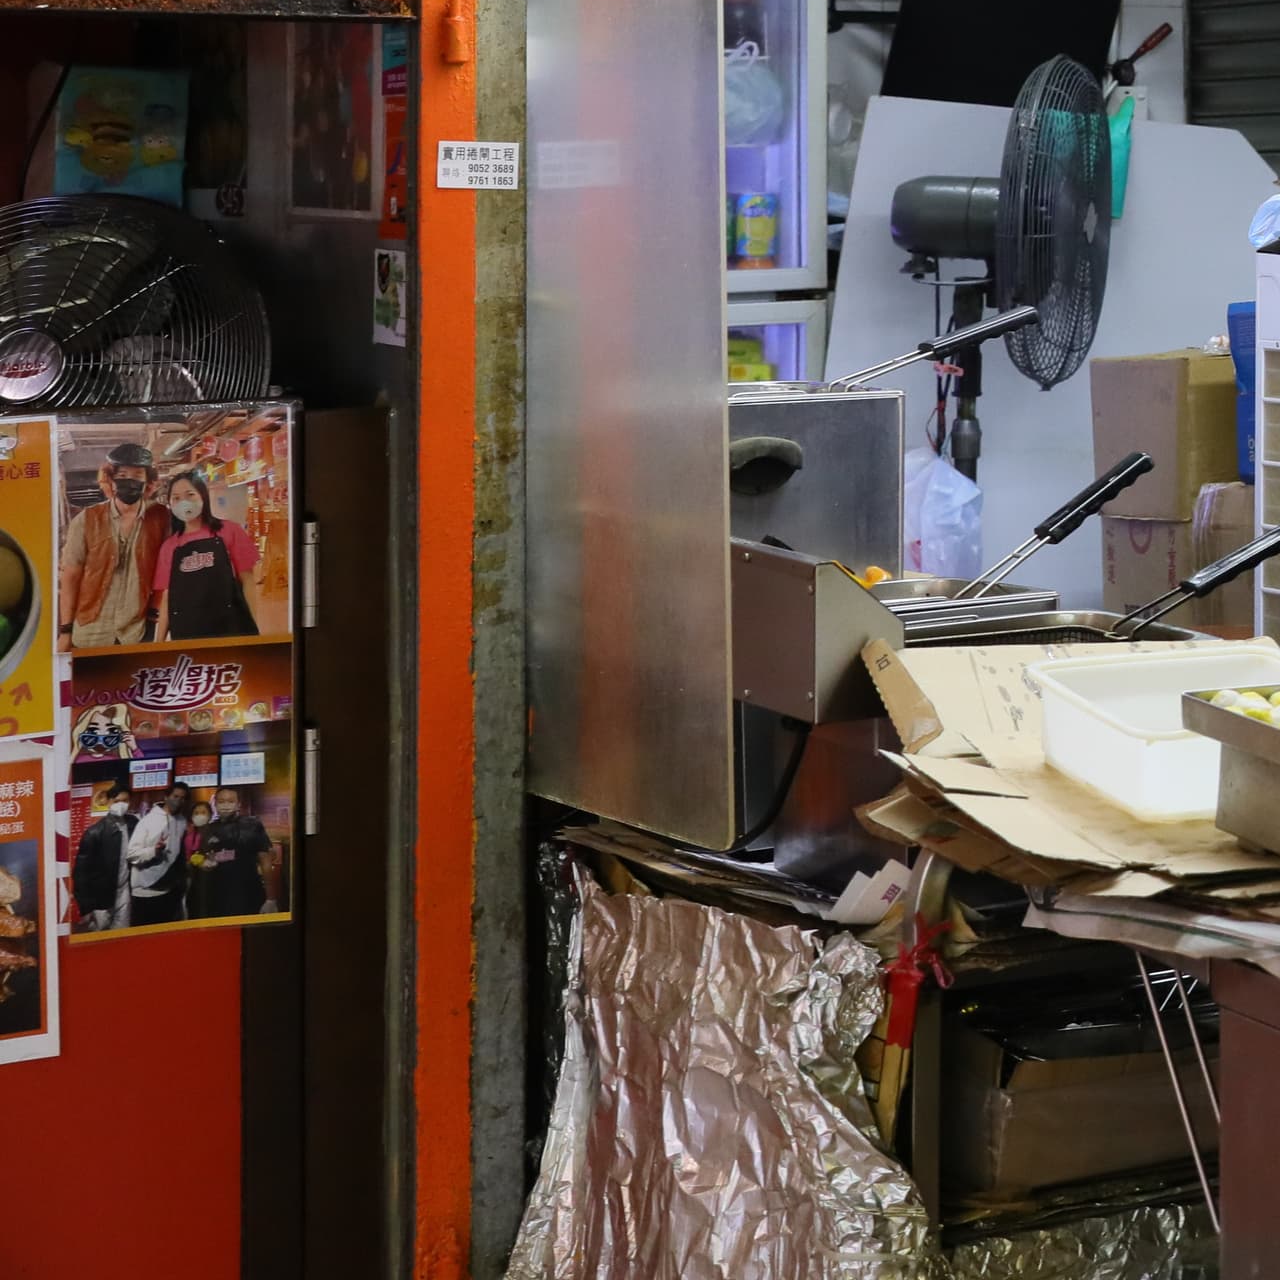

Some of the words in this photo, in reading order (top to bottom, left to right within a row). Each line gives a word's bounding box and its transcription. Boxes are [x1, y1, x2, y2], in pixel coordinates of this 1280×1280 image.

[468, 164, 489, 173] 9052
[468, 177, 489, 185] 9761
[493, 177, 513, 186] 1863
